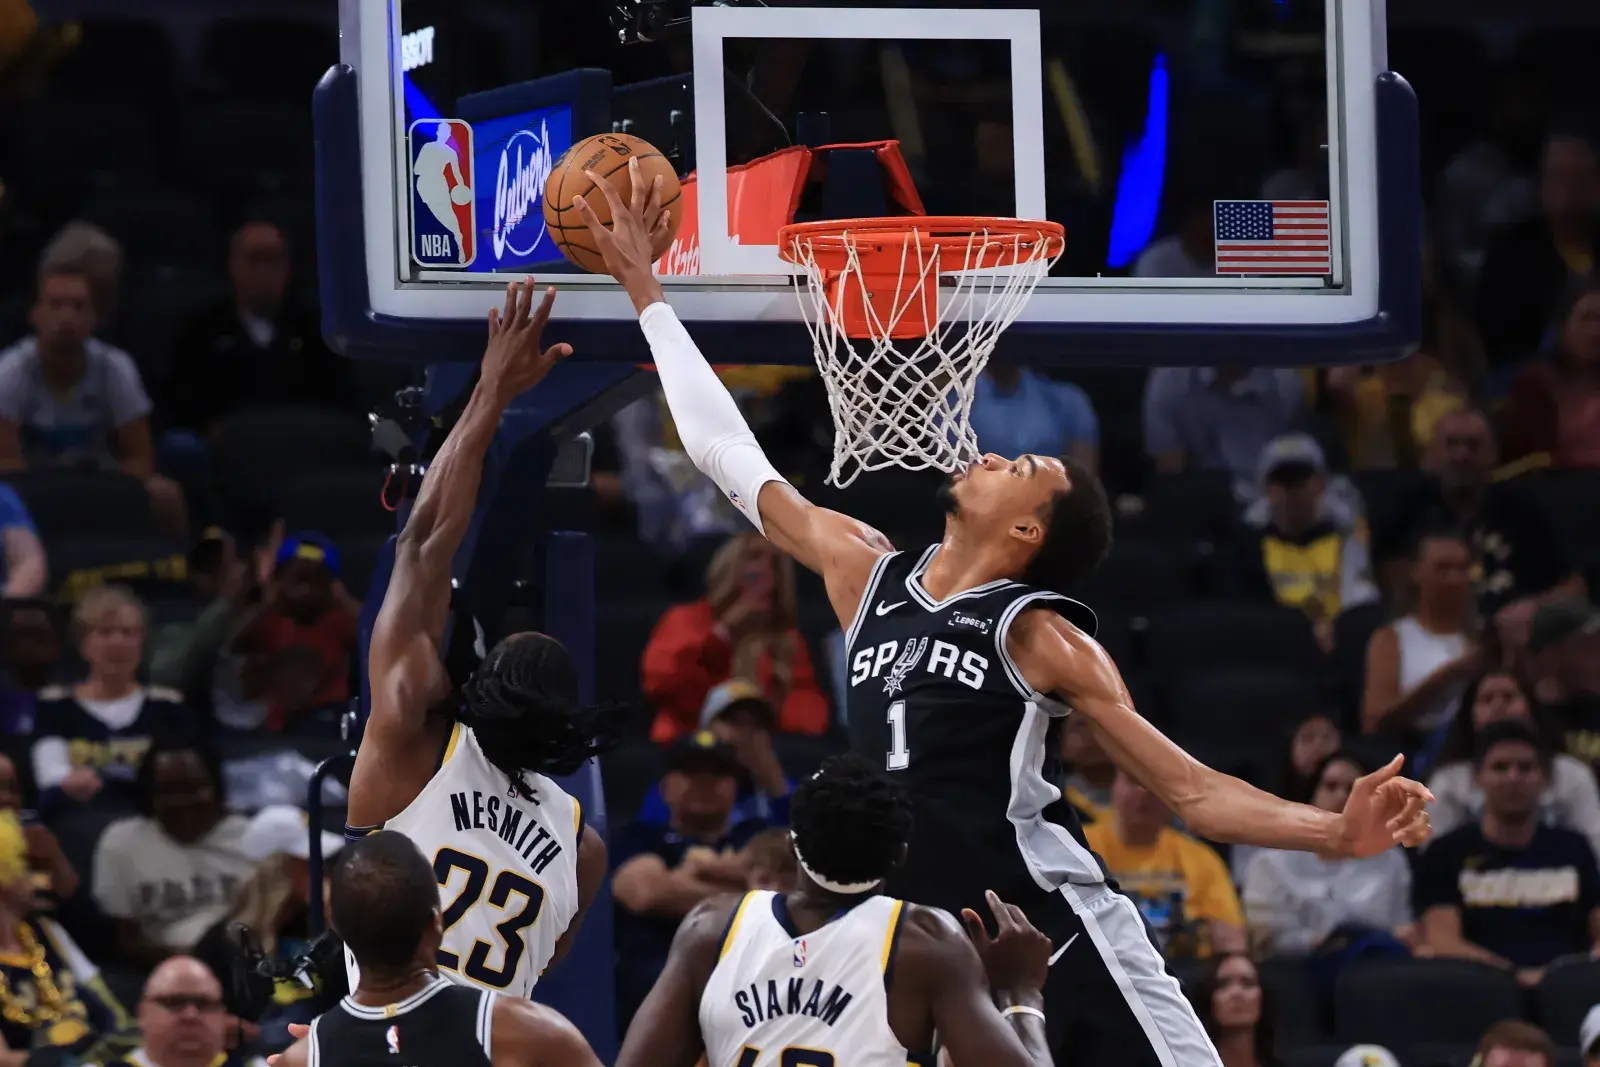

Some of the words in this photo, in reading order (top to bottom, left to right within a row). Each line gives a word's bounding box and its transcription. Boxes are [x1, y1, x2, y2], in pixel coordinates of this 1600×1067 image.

[421, 234, 452, 257] NBA
[954, 615, 987, 630] LEDGER
[886, 699, 910, 771] 1
[449, 791, 562, 876] NESMITH
[433, 846, 545, 990] 23
[735, 977, 853, 1028] SIAKAM
